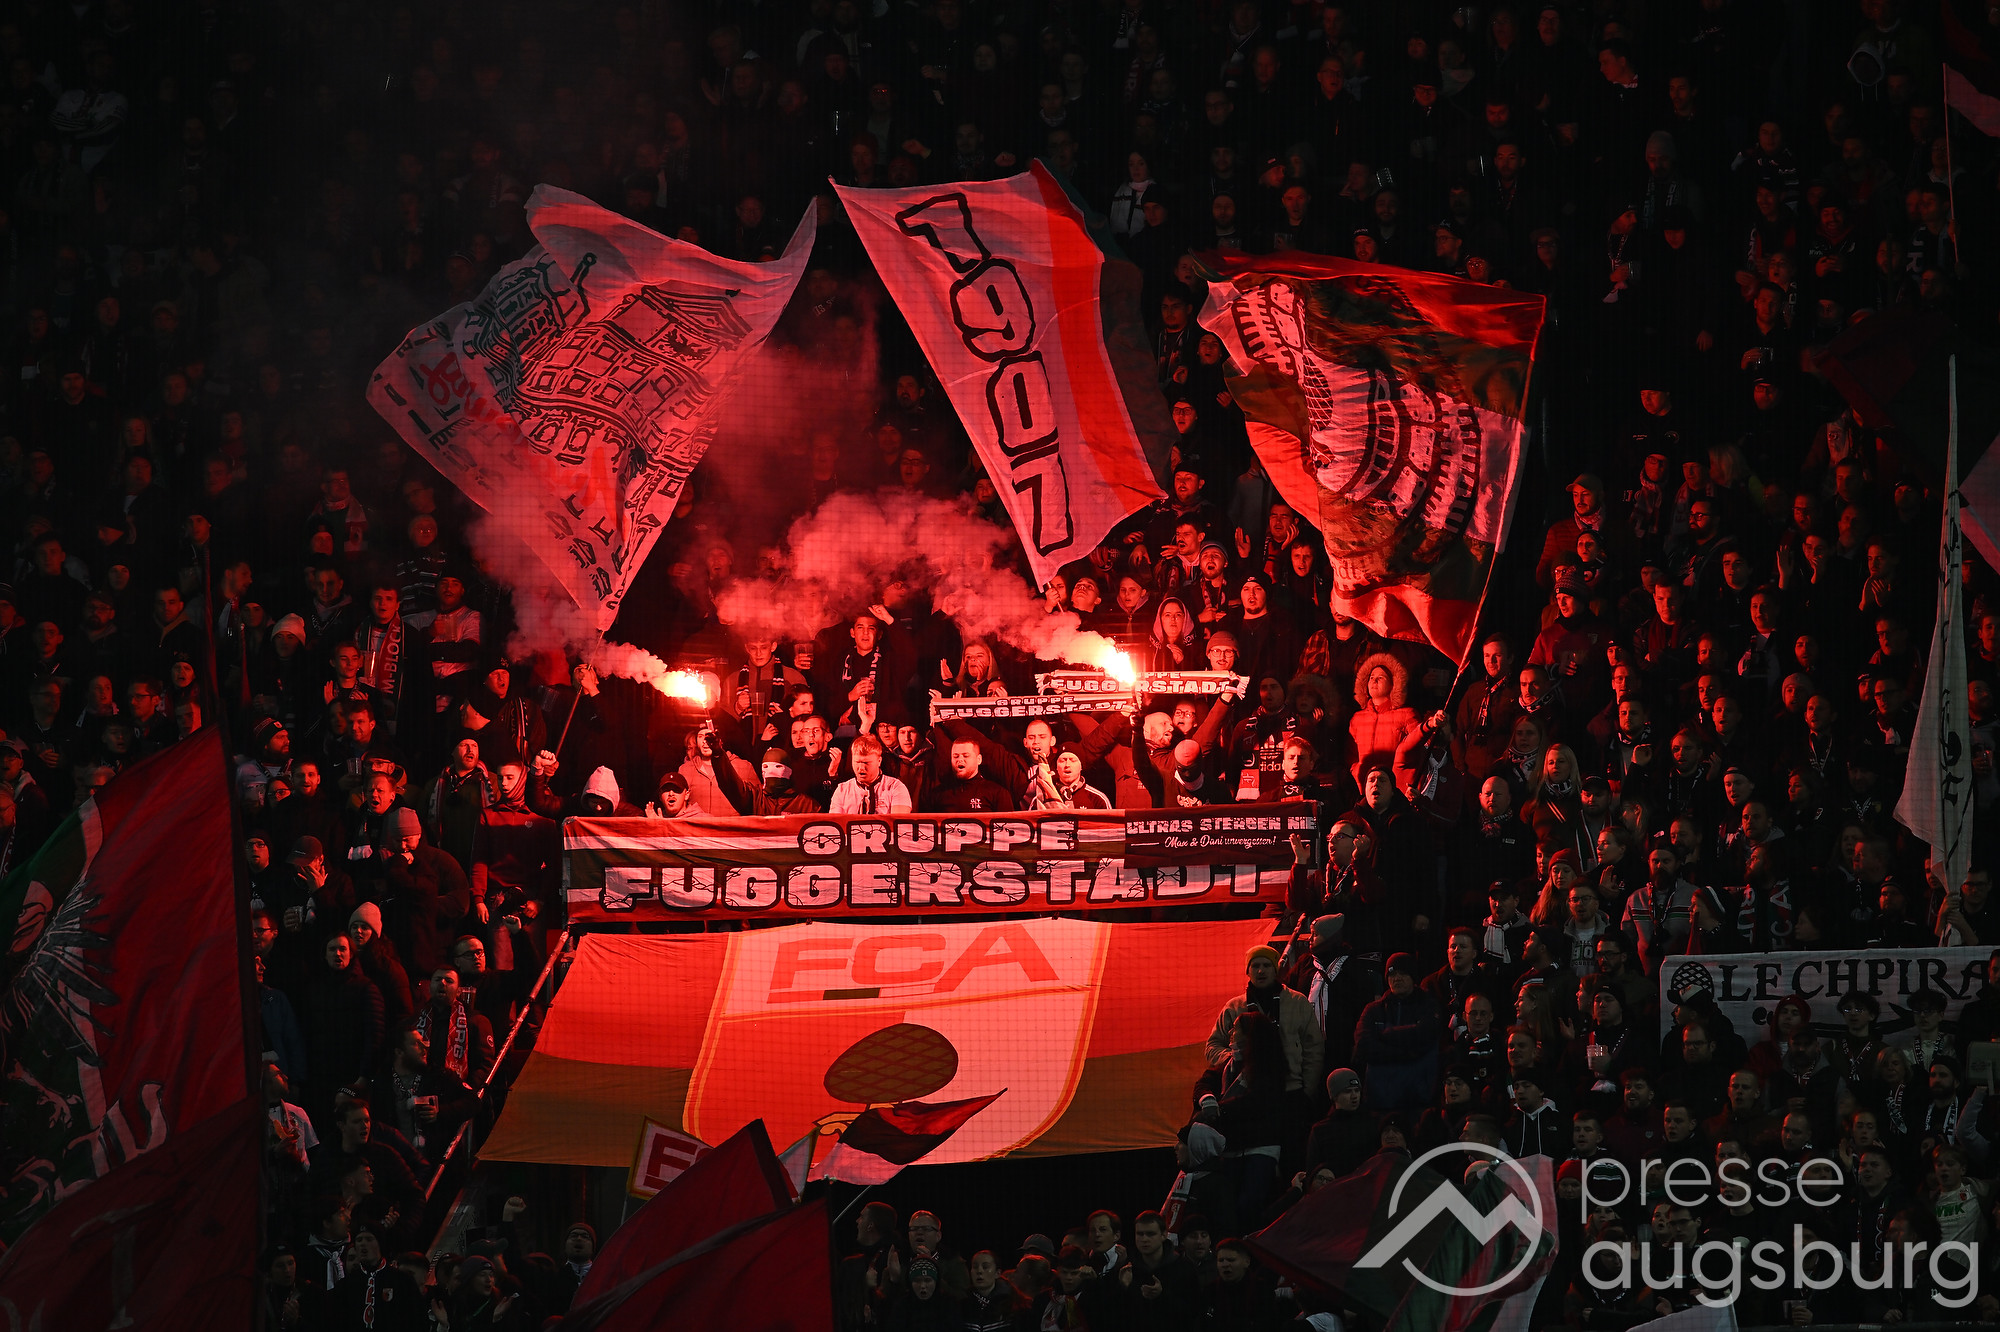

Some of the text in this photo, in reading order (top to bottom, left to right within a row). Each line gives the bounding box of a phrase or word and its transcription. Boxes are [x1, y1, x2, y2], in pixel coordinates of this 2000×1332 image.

[894, 192, 1074, 557] 1907
[382, 625, 402, 695] M-BLOCK
[938, 700, 1127, 720] FUGGERSTADT
[995, 695, 1075, 707] GRUPPE
[797, 819, 1083, 858] GRUPPE
[1126, 815, 1317, 835] ULTRAS STERBEN NIE
[1164, 834, 1278, 850] Max & Dani unvergessen!
[598, 856, 1261, 913] FUGGERSTADT
[766, 922, 1060, 994] FCA
[1934, 1202, 1966, 1218] WWK
